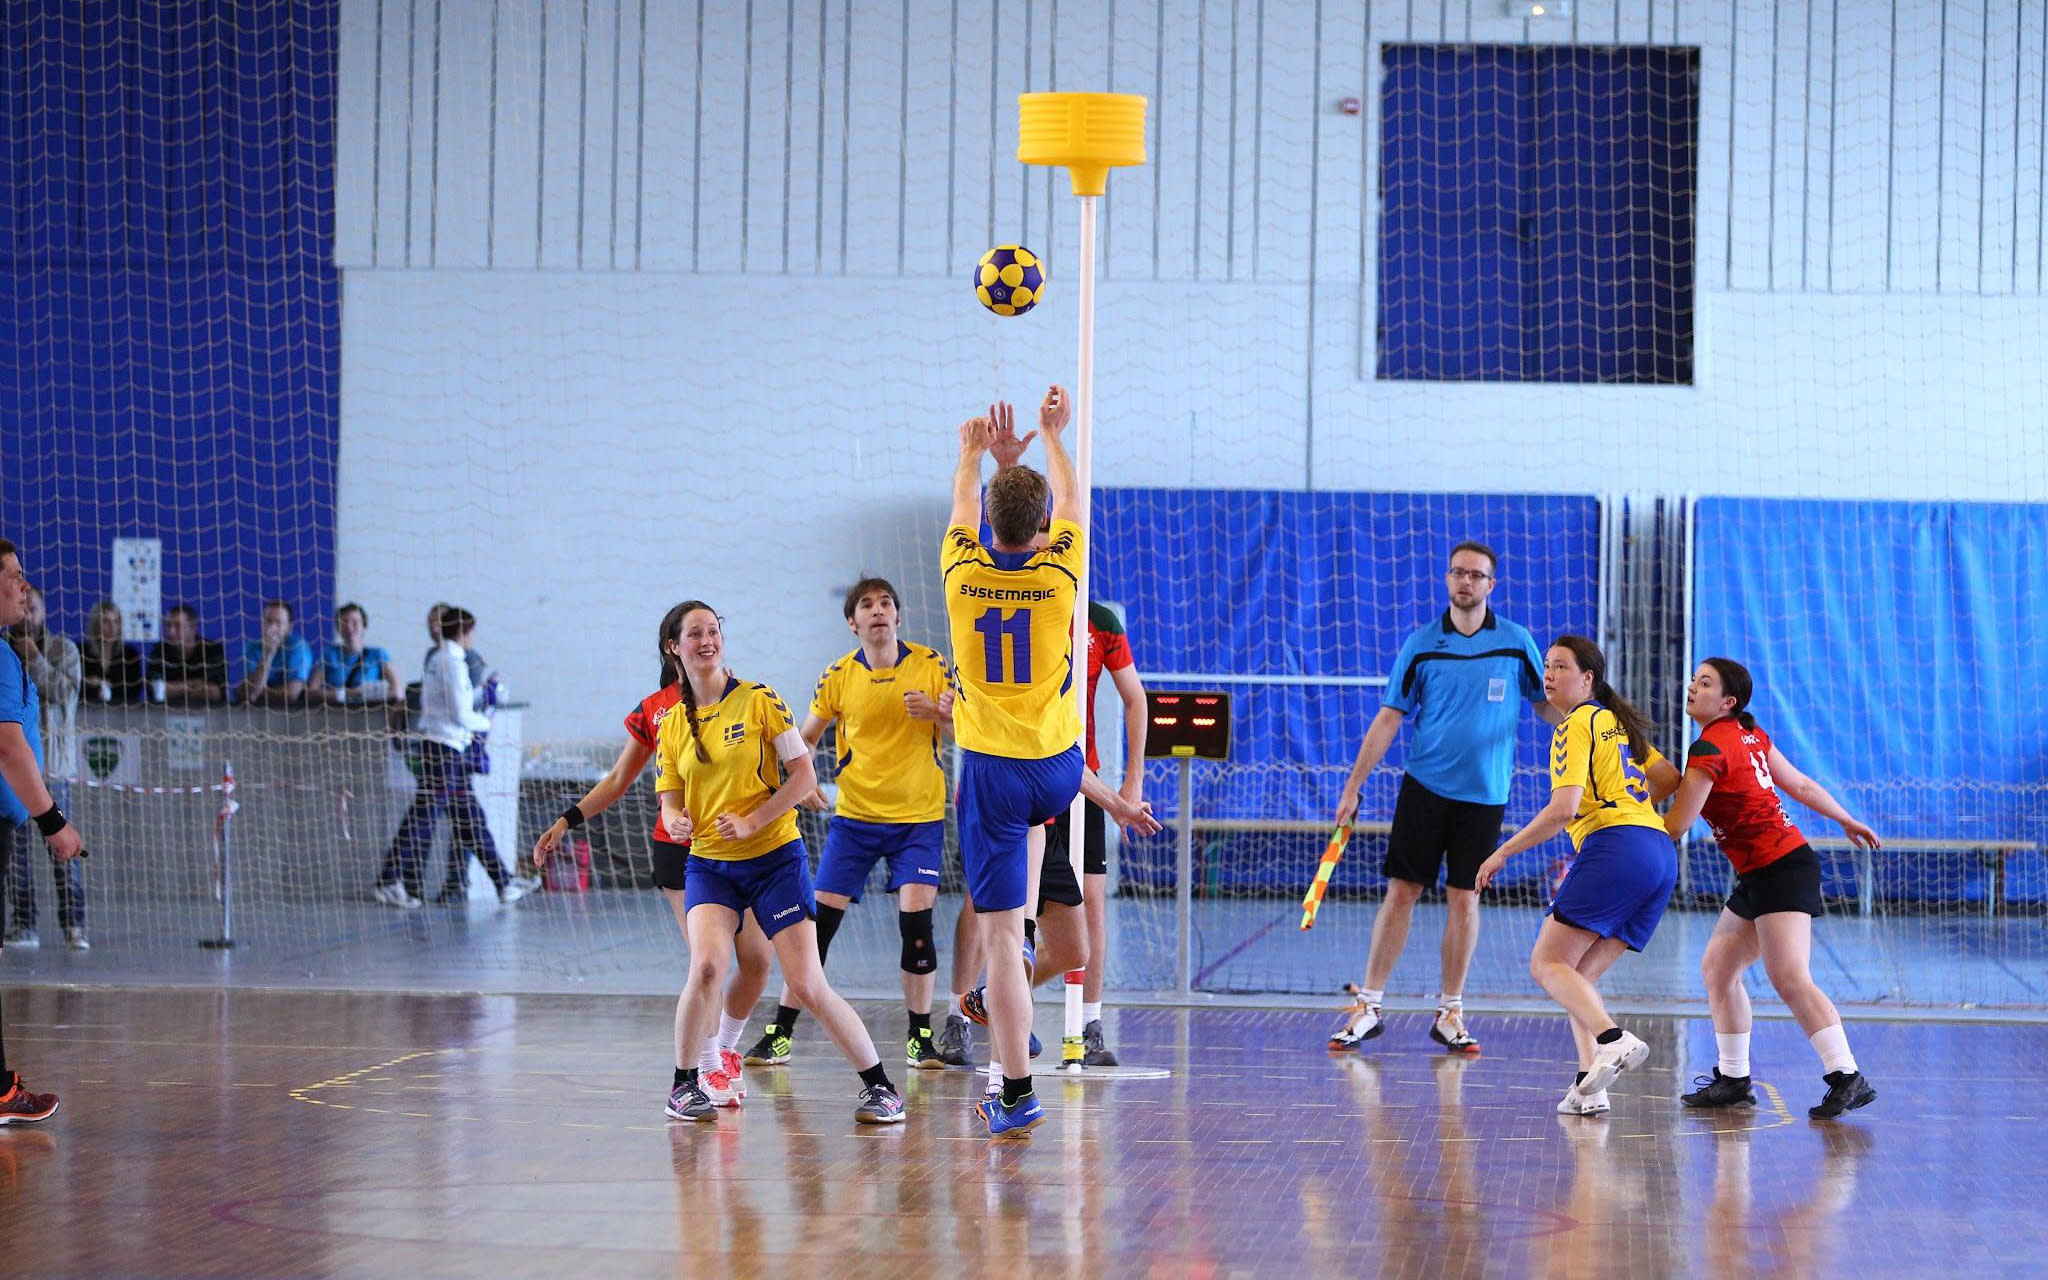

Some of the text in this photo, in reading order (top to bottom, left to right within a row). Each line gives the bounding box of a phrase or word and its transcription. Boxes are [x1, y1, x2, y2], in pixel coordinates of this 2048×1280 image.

[975, 607, 1031, 683] 11
[1618, 743, 1649, 803] 5
[1749, 750, 1776, 797] 4
[773, 903, 801, 921] hummel
